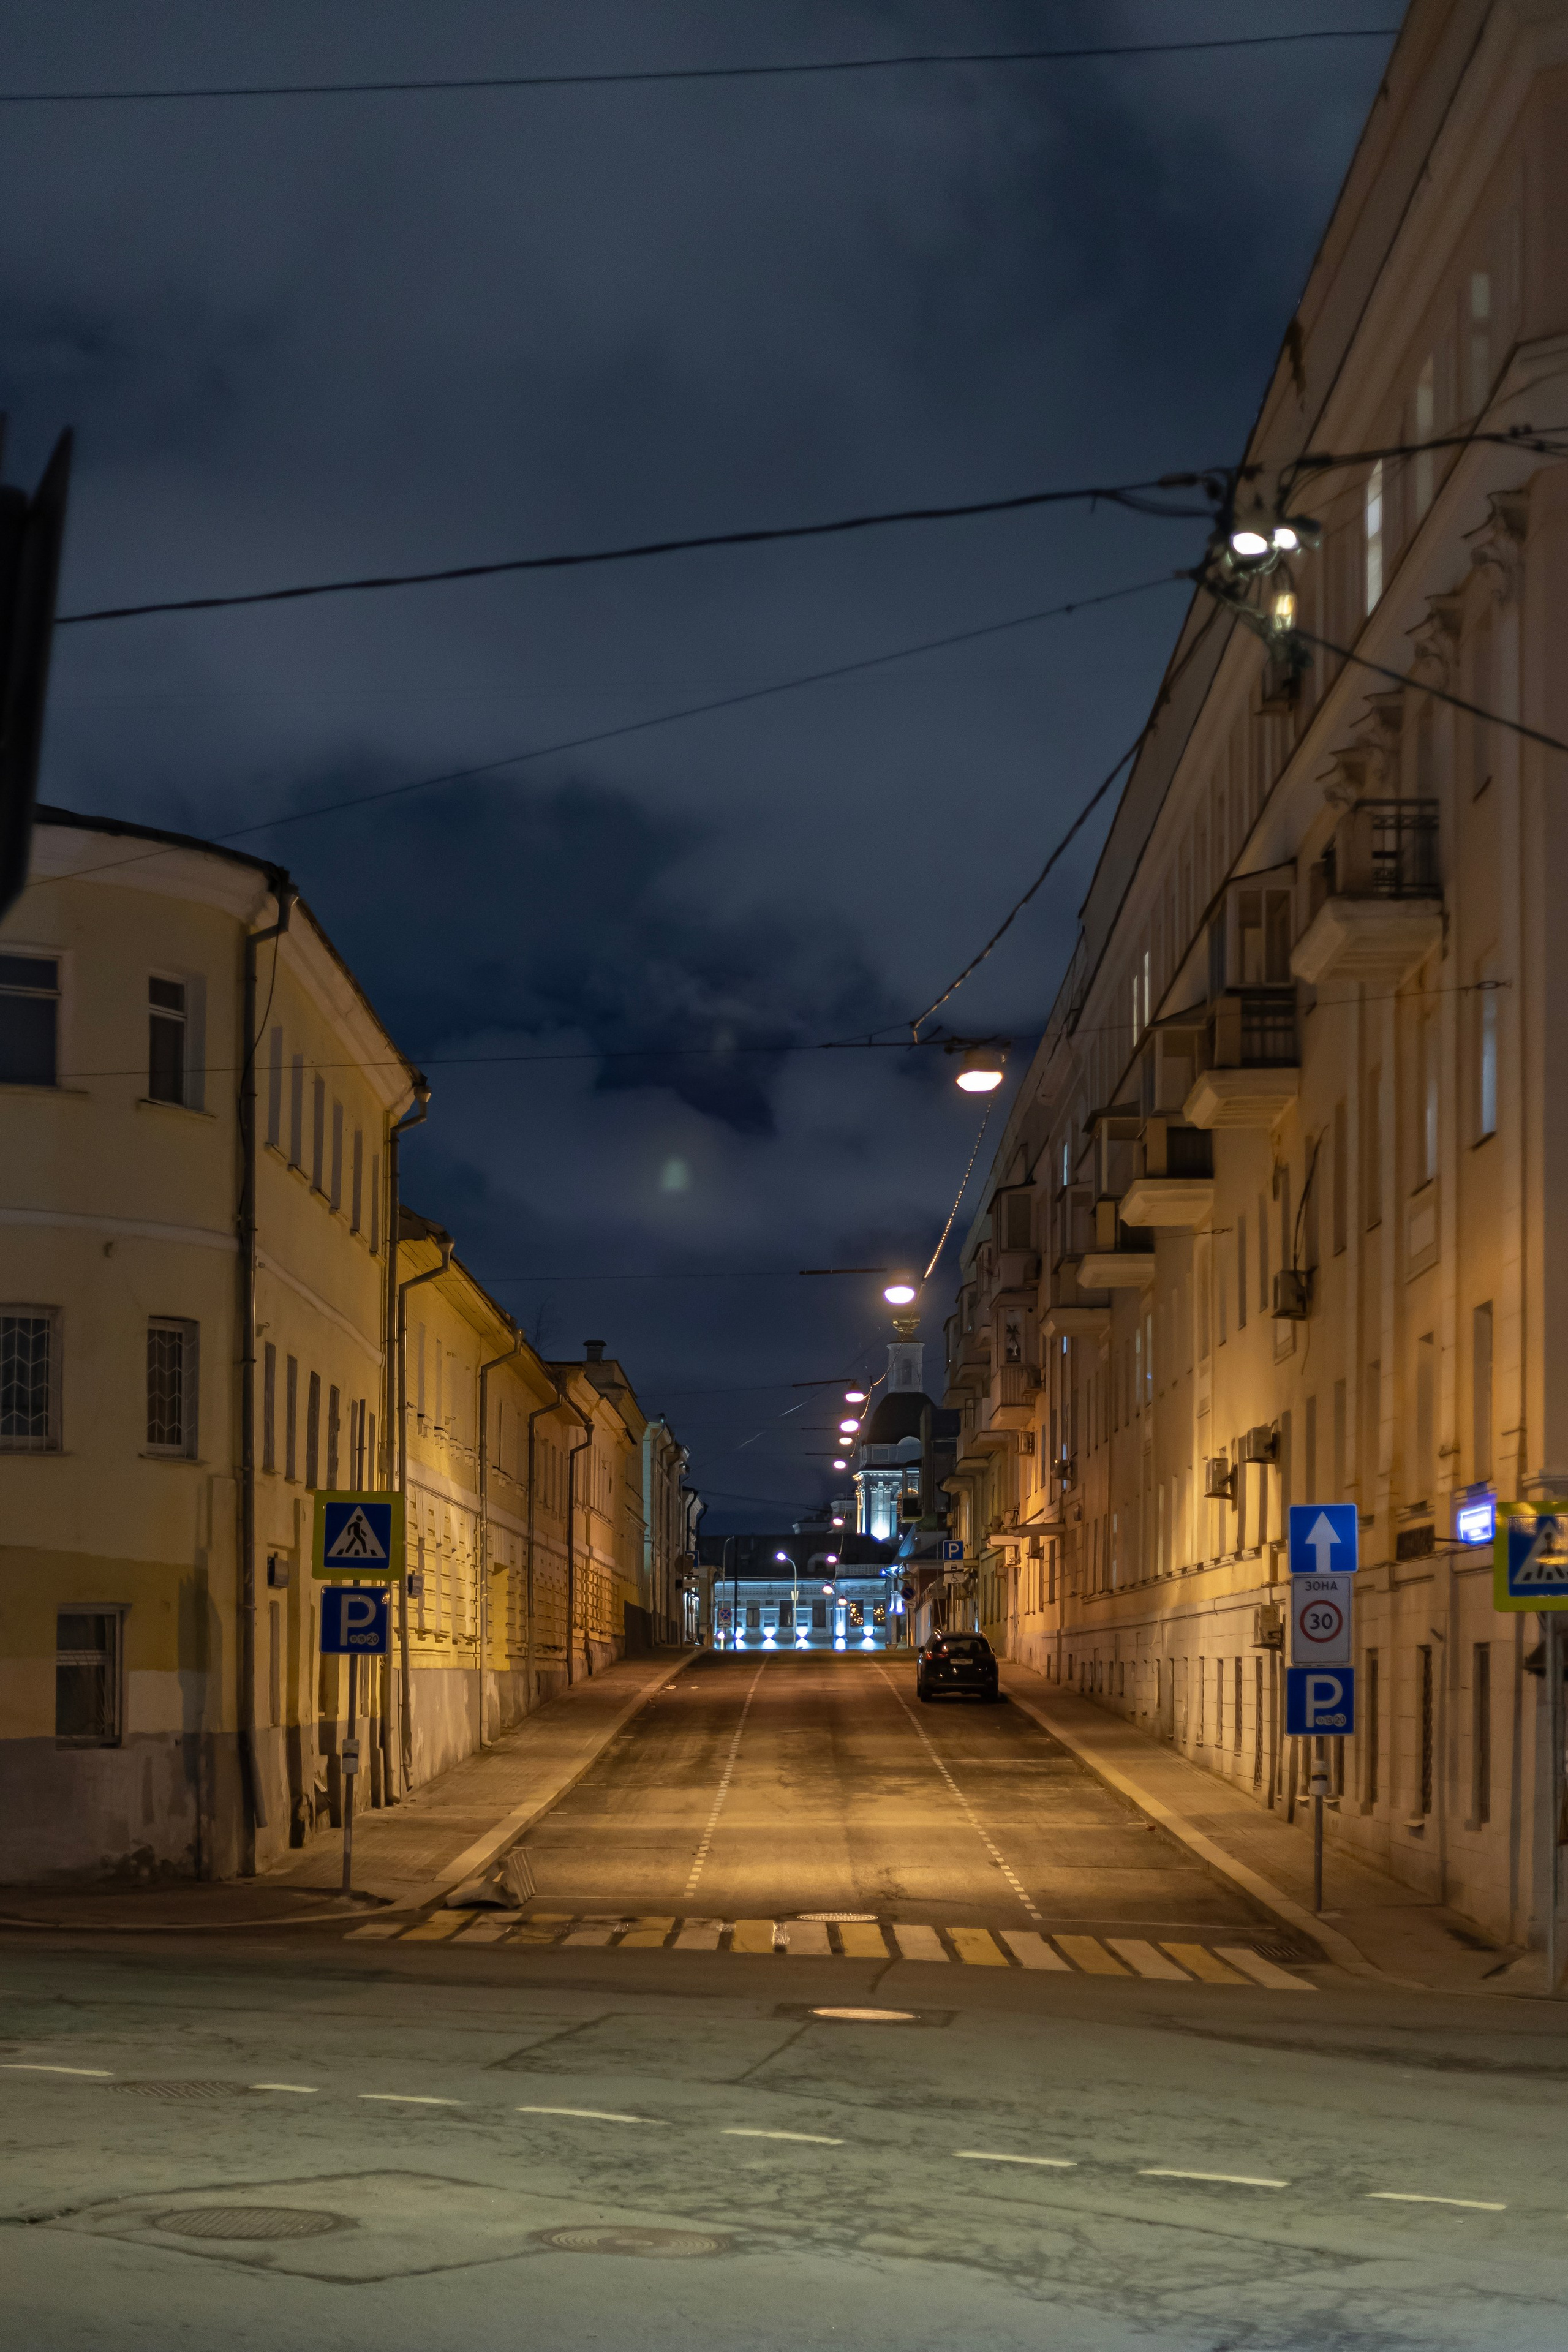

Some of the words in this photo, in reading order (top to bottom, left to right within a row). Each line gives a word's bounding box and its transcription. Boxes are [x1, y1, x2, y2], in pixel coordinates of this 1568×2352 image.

[949, 1543, 960, 1558] P
[1305, 1581, 1338, 1591] ЗОНА
[339, 1594, 377, 1646] P
[1310, 1613, 1333, 1630] 30
[1306, 1675, 1343, 1728] P
